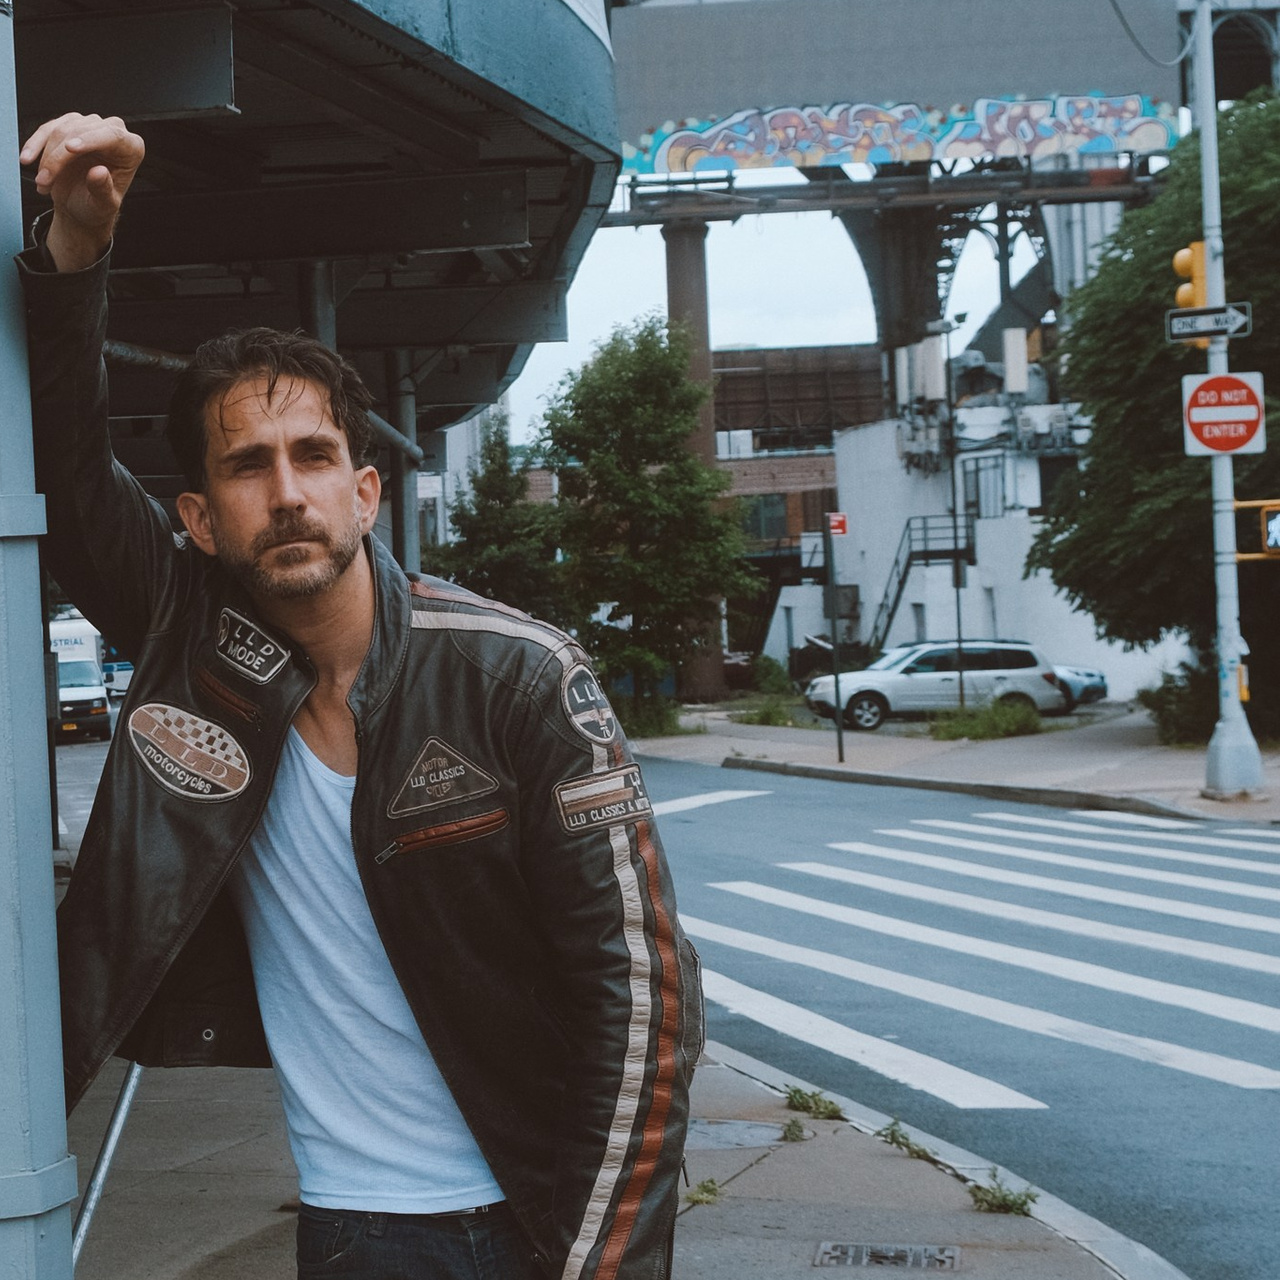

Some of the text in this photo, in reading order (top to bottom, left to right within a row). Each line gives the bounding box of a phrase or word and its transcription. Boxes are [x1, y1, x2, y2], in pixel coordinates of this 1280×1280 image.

[1197, 389, 1248, 405] DO NOT
[1202, 423, 1247, 439] ENTER
[51, 638, 83, 647] STRIAL
[226, 640, 266, 671] MODE
[143, 743, 213, 795] motorcycles
[421, 757, 449, 773] MOTOR
[410, 764, 466, 788] LLD CLASSICS
[568, 813, 587, 827] LLD
[590, 802, 627, 821] CLASSICS
